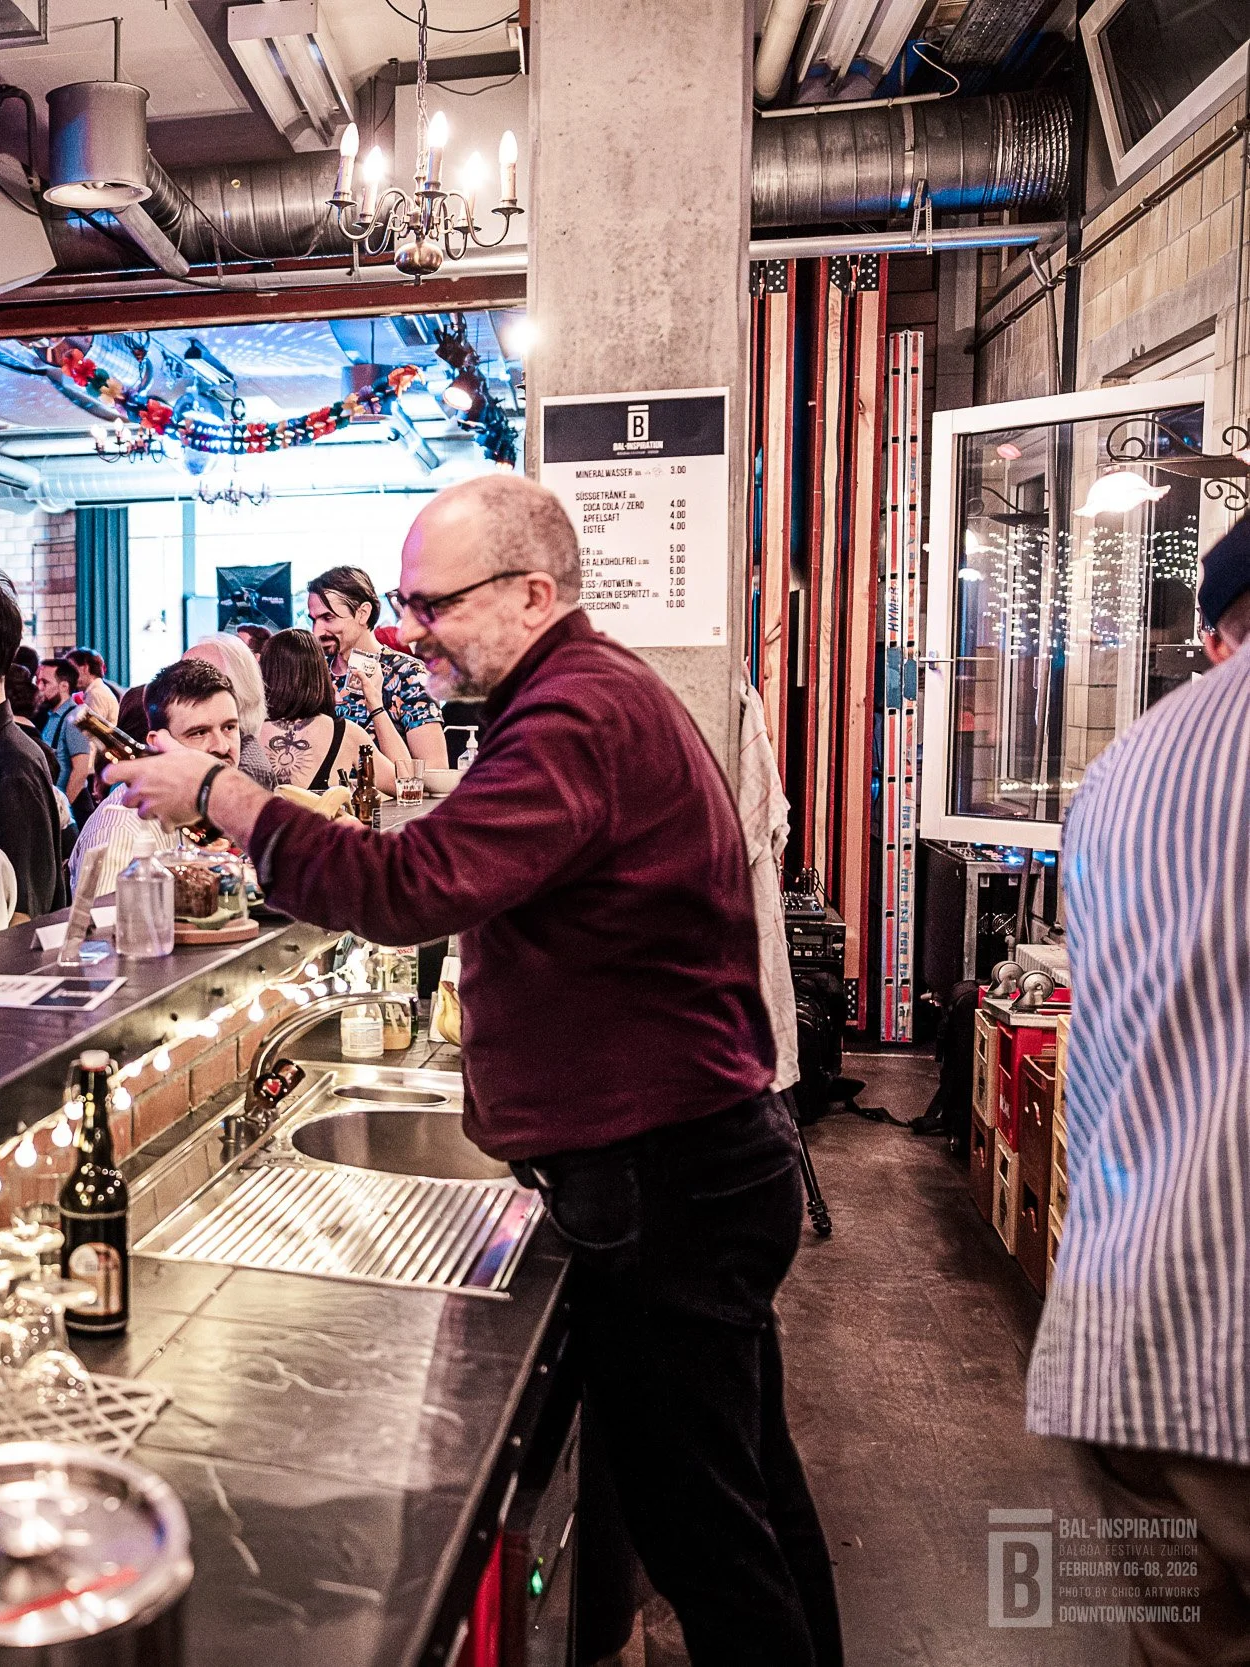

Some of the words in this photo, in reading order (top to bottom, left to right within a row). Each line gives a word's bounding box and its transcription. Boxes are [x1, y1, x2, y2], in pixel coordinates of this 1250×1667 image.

[633, 415, 644, 438] B
[575, 468, 633, 479] MINERALWASSER
[670, 465, 687, 475] 3.00
[575, 490, 627, 501] SÜSSGETRÄNKE
[583, 503, 600, 512] COCA
[602, 502, 619, 511] COLA
[626, 501, 645, 510] ZERO
[670, 499, 686, 508] 4.00
[583, 513, 620, 523] APFELSAFT
[670, 510, 686, 519] 4.00
[583, 525, 606, 534] EISTEE
[670, 521, 686, 530] 4.00
[670, 544, 686, 553] 5.00
[592, 557, 637, 567] ALKOHOLFREI
[670, 555, 686, 564] 5.00
[581, 569, 594, 578] OST
[670, 566, 686, 575] 6.00
[581, 579, 633, 589] EISS-/ROTWEIN
[670, 577, 686, 586] 7.00
[581, 591, 613, 600] EISSWEIN
[614, 589, 650, 599] GESPRITZT
[670, 588, 686, 597] 5.00
[579, 602, 621, 611] ROSECCHINO
[666, 600, 686, 609] 10.00
